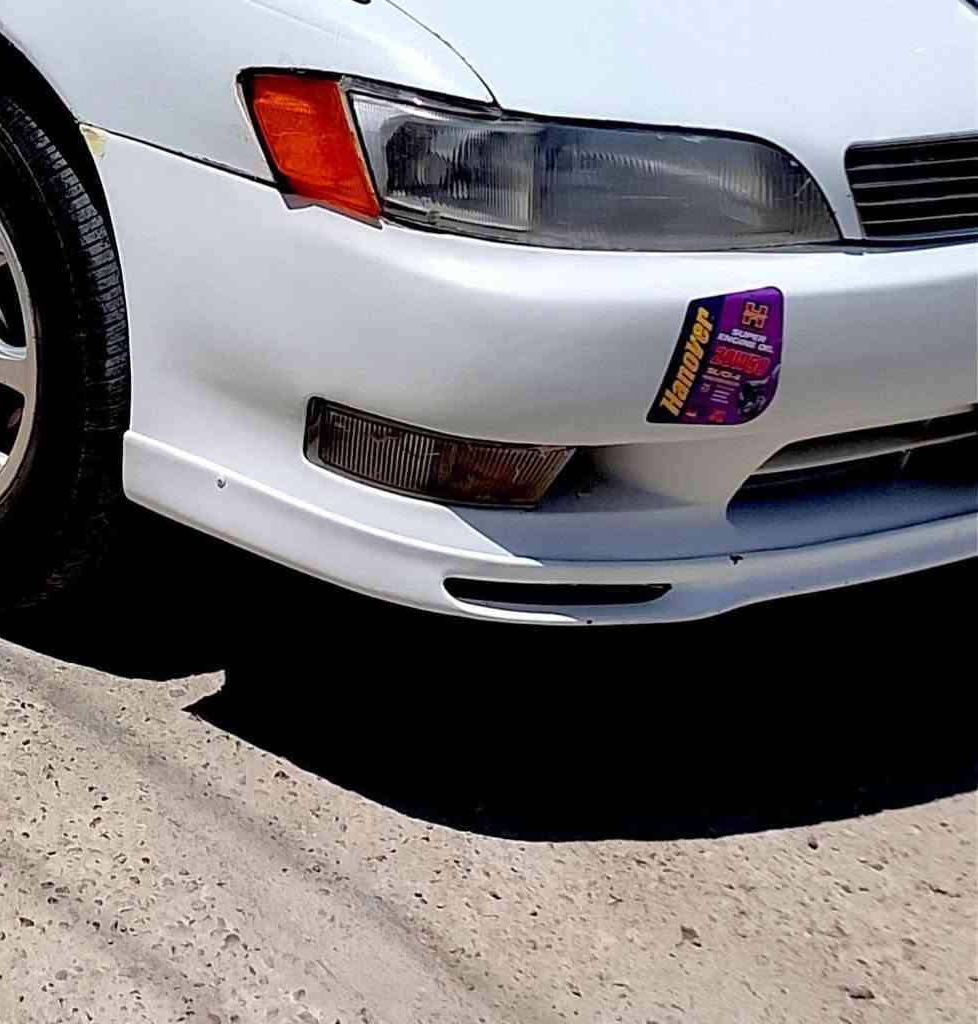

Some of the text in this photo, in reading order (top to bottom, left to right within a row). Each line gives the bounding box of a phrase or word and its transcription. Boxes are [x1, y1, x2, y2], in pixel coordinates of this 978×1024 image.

[717, 333, 756, 349] ENGINE
[731, 328, 767, 343] SUPER
[658, 307, 713, 417] Hanover
